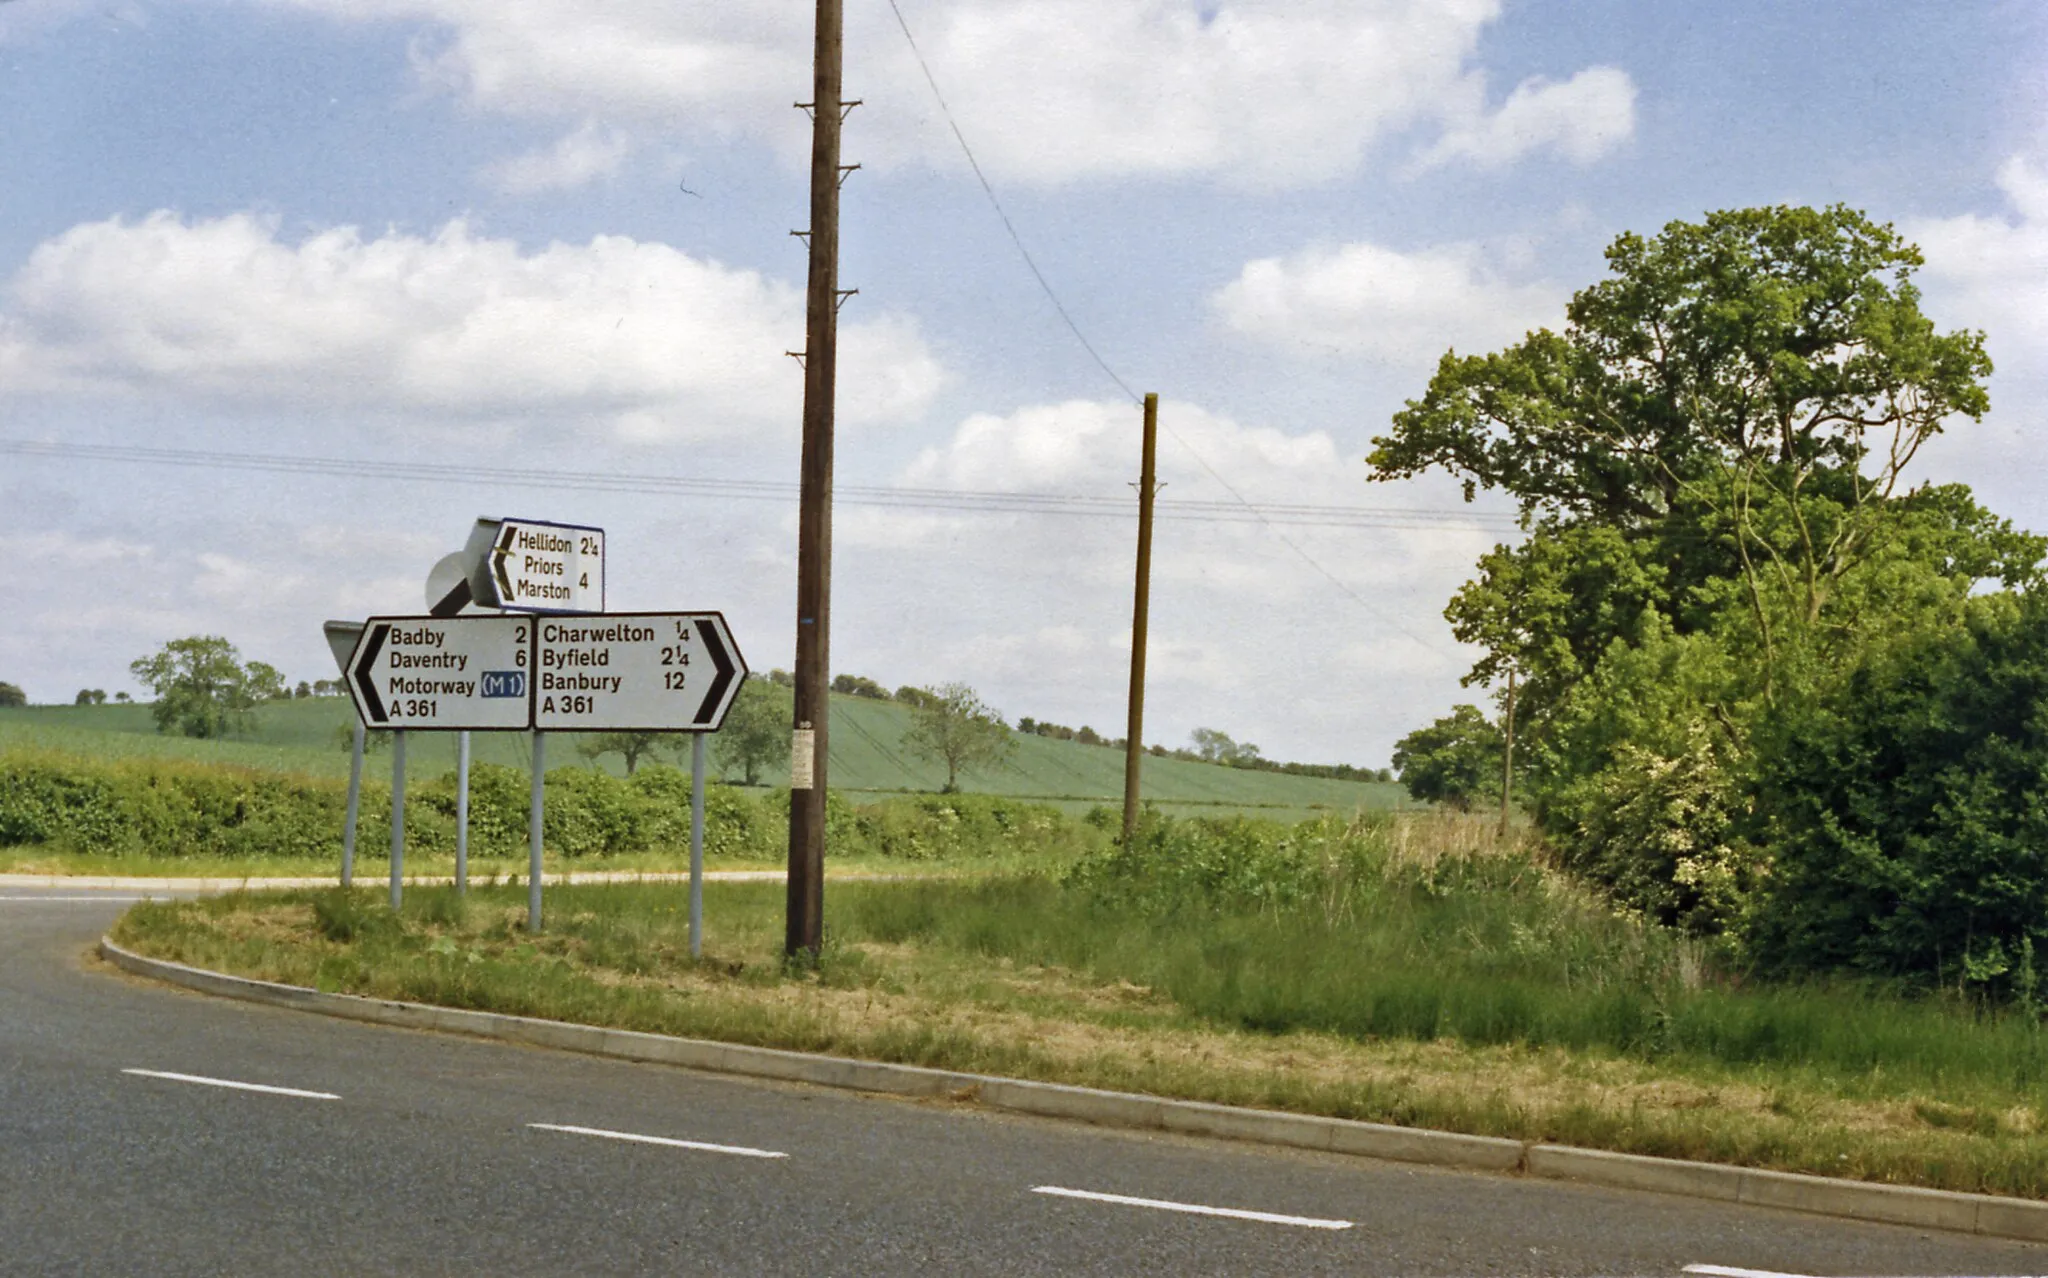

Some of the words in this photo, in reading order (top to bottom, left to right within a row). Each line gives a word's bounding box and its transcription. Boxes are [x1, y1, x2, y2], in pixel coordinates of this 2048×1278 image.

[518, 531, 572, 553] Hellidon
[525, 556, 563, 575] Priors
[517, 579, 570, 599] Marston
[579, 572, 588, 589] 4
[390, 628, 445, 648] Badby
[515, 626, 526, 643] 2
[543, 624, 654, 643] Charwelton
[390, 652, 468, 671] Daventry
[515, 650, 526, 667] 6
[543, 648, 609, 670] Byfield
[389, 677, 475, 697] Motorway
[543, 672, 621, 693] Banbury
[664, 672, 685, 690] 12
